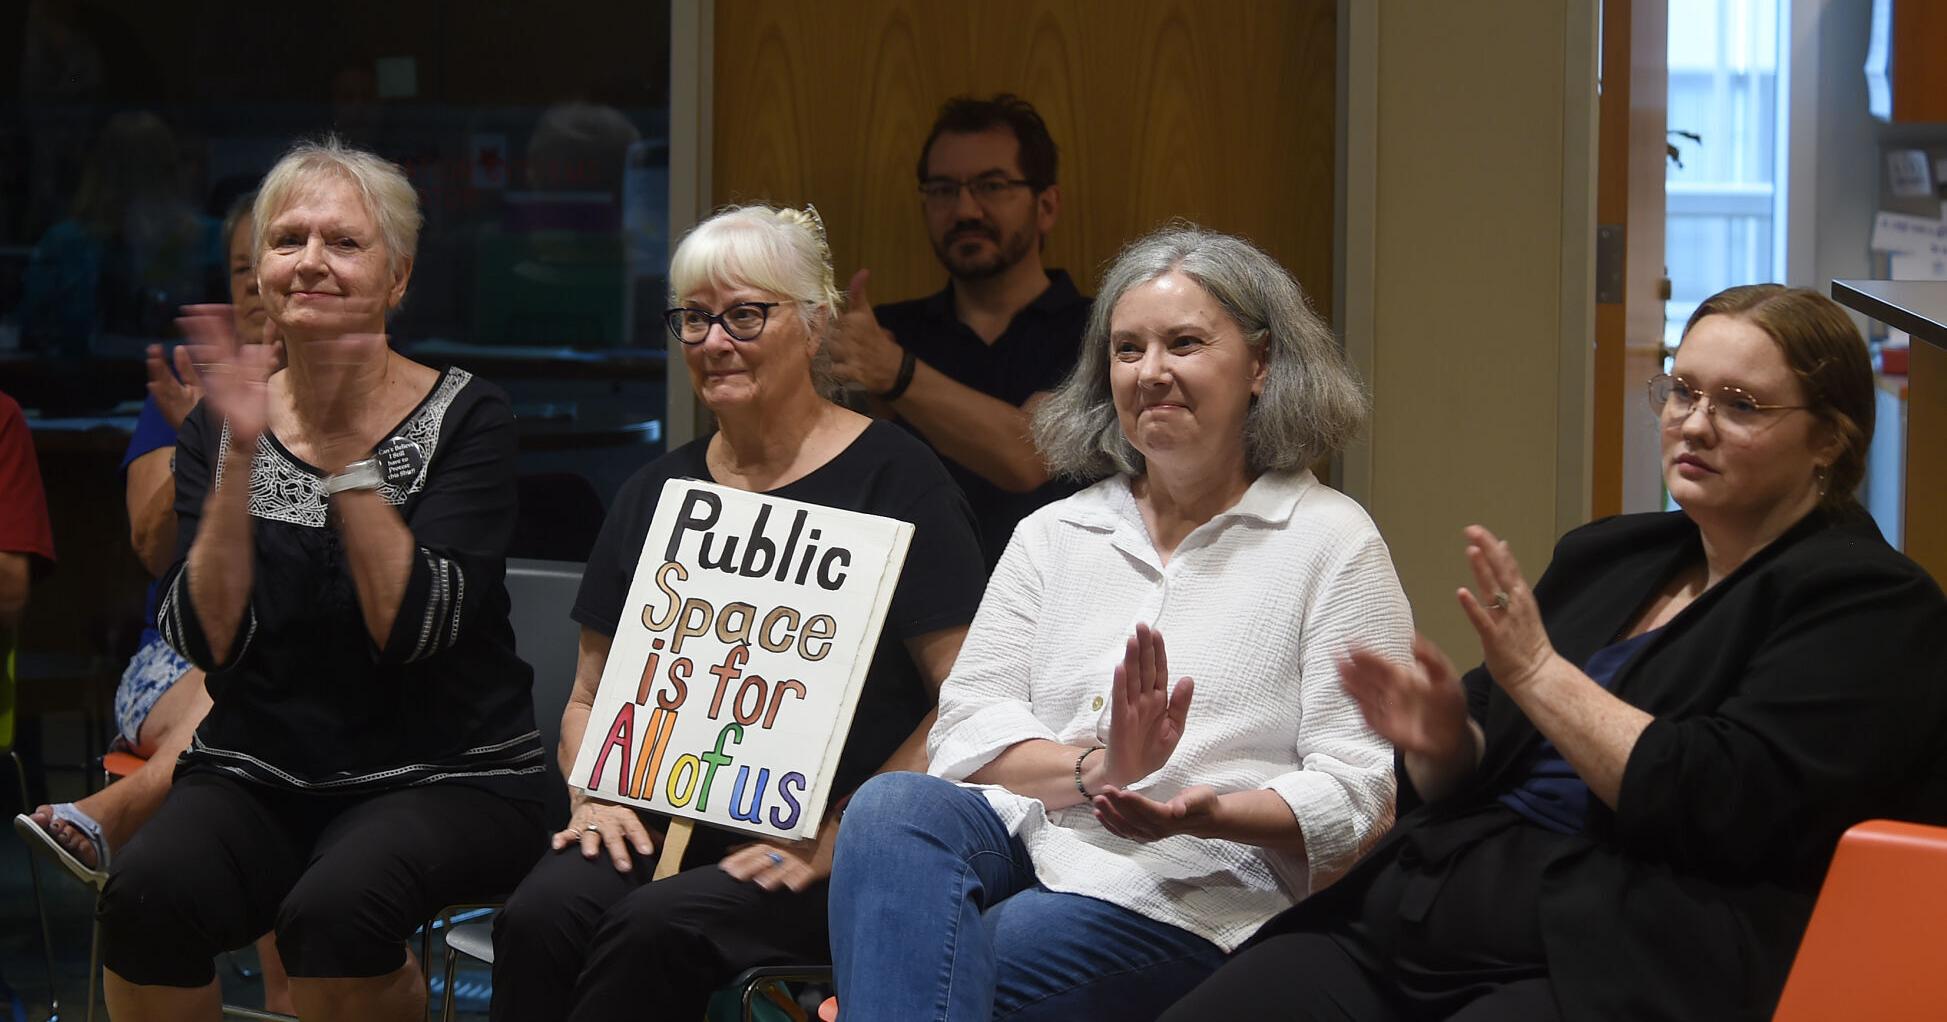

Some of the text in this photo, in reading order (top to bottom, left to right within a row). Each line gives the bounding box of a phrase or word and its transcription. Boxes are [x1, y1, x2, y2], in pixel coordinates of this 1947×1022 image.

[389, 463, 410, 473] Protest
[664, 488, 852, 590] Public
[641, 561, 837, 661] Space
[635, 638, 807, 729] is for
[587, 702, 806, 830] All of us
